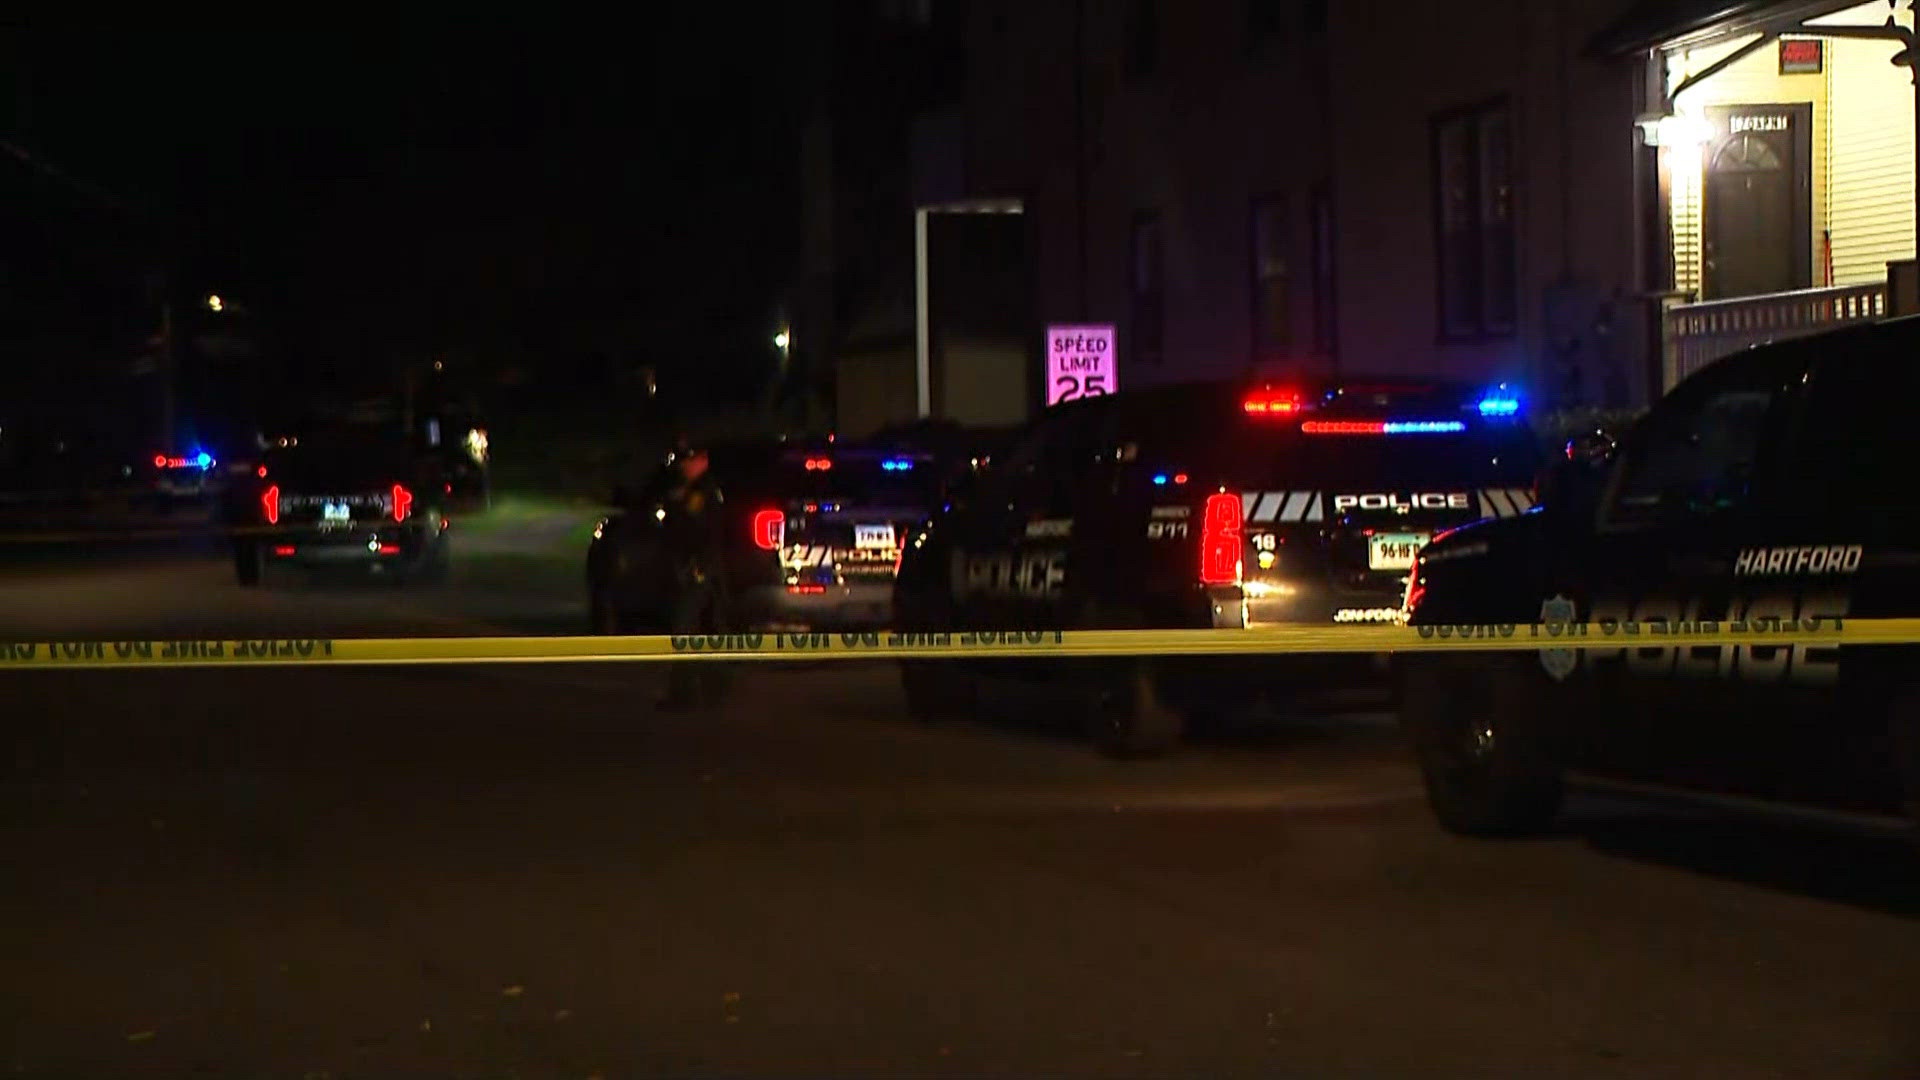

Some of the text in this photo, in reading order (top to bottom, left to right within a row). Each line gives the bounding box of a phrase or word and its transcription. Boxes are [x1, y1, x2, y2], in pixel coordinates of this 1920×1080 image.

[1055, 338, 1107, 353] SPEED
[1060, 356, 1099, 372] LIMIT
[1056, 376, 1105, 404] 25
[1334, 493, 1468, 514] POLICE
[1147, 521, 1189, 541] 911
[1735, 544, 1864, 577] HARTFORD
